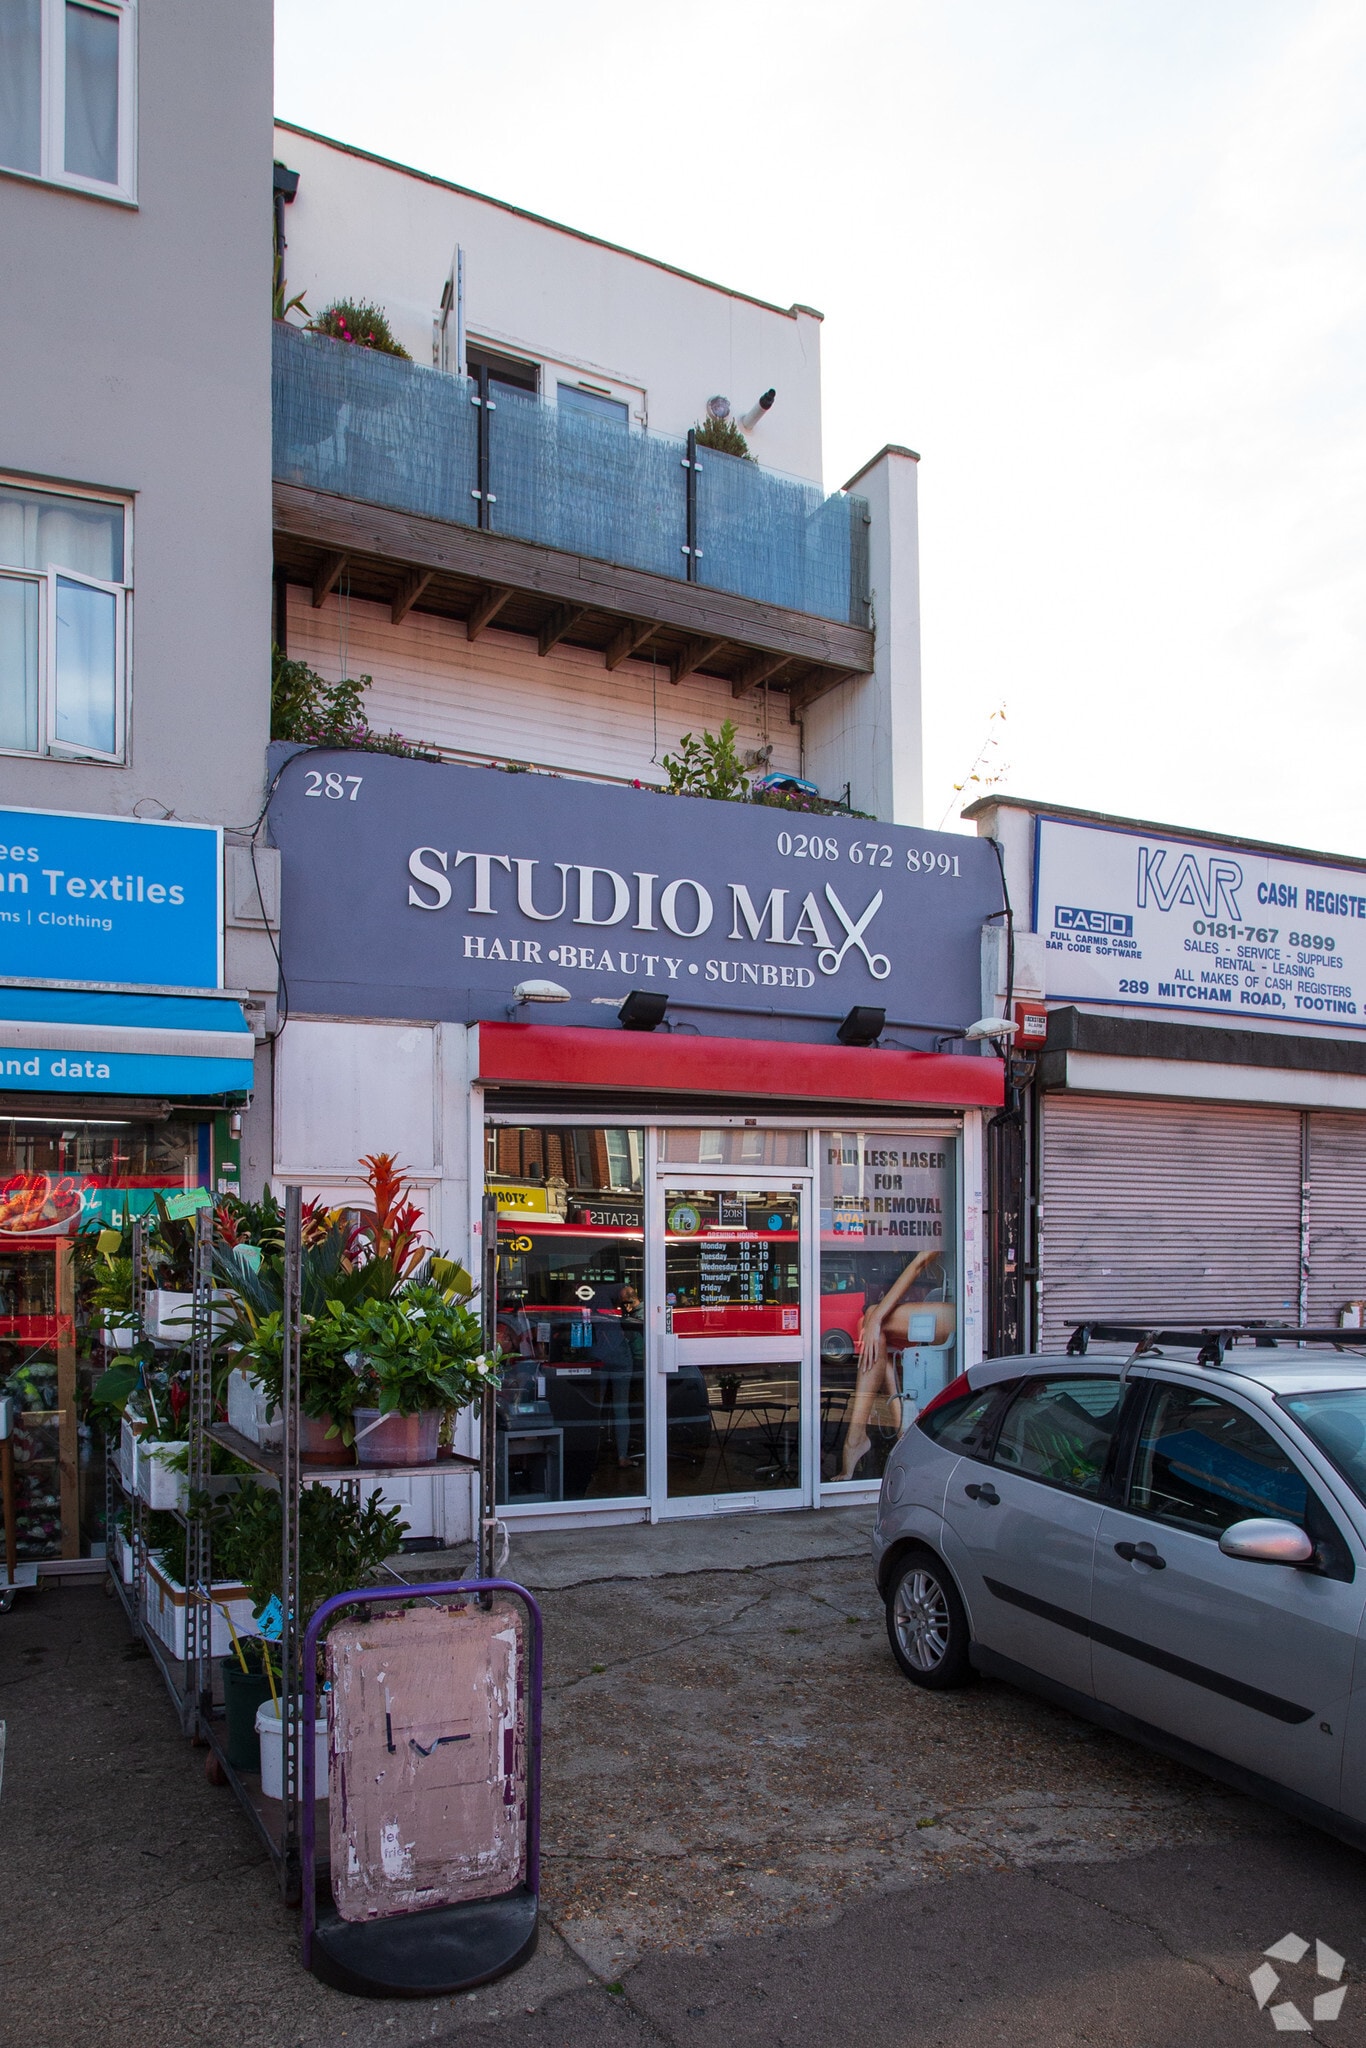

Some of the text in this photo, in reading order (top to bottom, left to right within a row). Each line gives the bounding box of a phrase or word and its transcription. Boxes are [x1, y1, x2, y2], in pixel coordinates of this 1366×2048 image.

[304, 770, 363, 801] 287
[777, 831, 962, 877] 0208 672 8991
[42, 869, 185, 905] Textiles
[408, 846, 714, 938] STUDIO
[1137, 846, 1243, 921] KAR
[1257, 882, 1366, 919] CASH REGISTE
[38, 911, 113, 931] Clothing
[1057, 908, 1127, 934] CASIO
[1050, 931, 1137, 949] FULL CARMIS CASIO
[1193, 920, 1335, 951] 0181-767 8899
[1045, 940, 1142, 959] BAR CODE SOFTWARE
[1184, 938, 1219, 954] SALES
[1237, 945, 1281, 960] SERVICE
[1297, 951, 1343, 968] SUPPLIES
[1215, 956, 1255, 972] RENTAL
[1273, 962, 1315, 978] LEASING
[1174, 968, 1352, 998] ALL MAKES OF CASH REGISTERS
[1119, 979, 1149, 995] 289
[1158, 982, 1232, 1004] MITCHAM
[1240, 990, 1286, 1010] ROAD,
[1294, 995, 1357, 1015] TOOTING
[0, 1057, 110, 1079] nd data
[902, 1151, 947, 1169] LASER
[874, 1173, 903, 1190] FOR
[723, 1209, 743, 1218] 2018
[874, 1197, 942, 1214] REMOVAL
[736, 1231, 759, 1239] HOURS
[701, 1242, 727, 1251] Monday
[739, 1241, 750, 1250] 10
[758, 1241, 769, 1250] 19
[700, 1252, 727, 1261] Tuesday
[739, 1251, 750, 1260] 10
[758, 1251, 769, 1260] 19
[700, 1263, 738, 1272] Wednesday
[739, 1262, 750, 1271] 10
[758, 1262, 769, 1271] 19
[701, 1273, 731, 1282] Thursday
[740, 1273, 749, 1281] 10
[755, 1273, 764, 1281] 19
[700, 1284, 722, 1292] Friday
[740, 1283, 749, 1291] 10
[754, 1283, 763, 1291] 20
[700, 1294, 731, 1303] Saturday
[701, 1304, 726, 1313] Sunday
